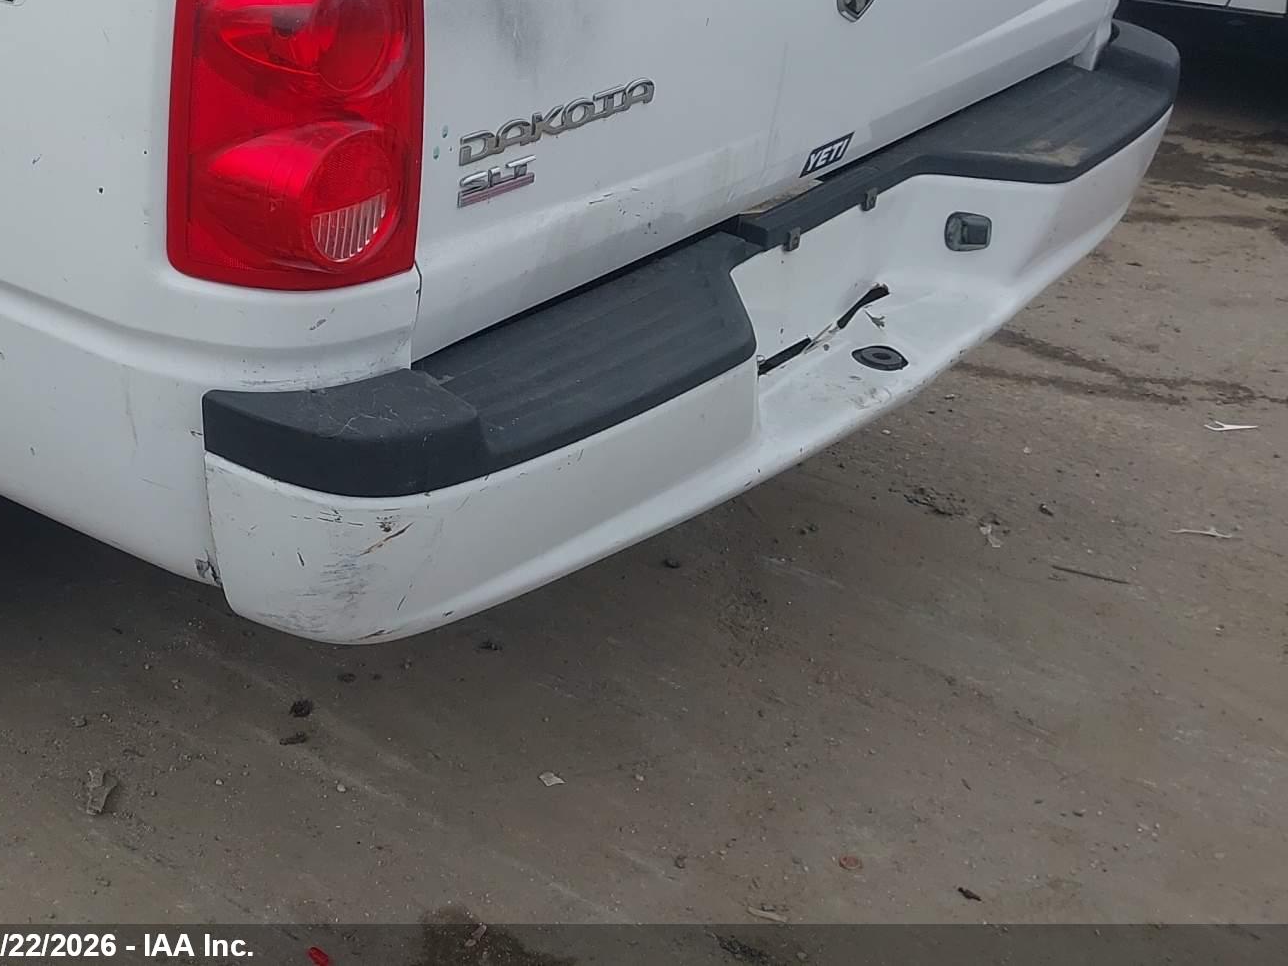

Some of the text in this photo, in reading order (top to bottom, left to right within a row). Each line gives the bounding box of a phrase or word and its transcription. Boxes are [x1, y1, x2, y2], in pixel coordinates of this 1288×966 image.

[458, 76, 655, 167] DAKOTA
[459, 154, 537, 193] SLT
[806, 137, 850, 172] YETI
